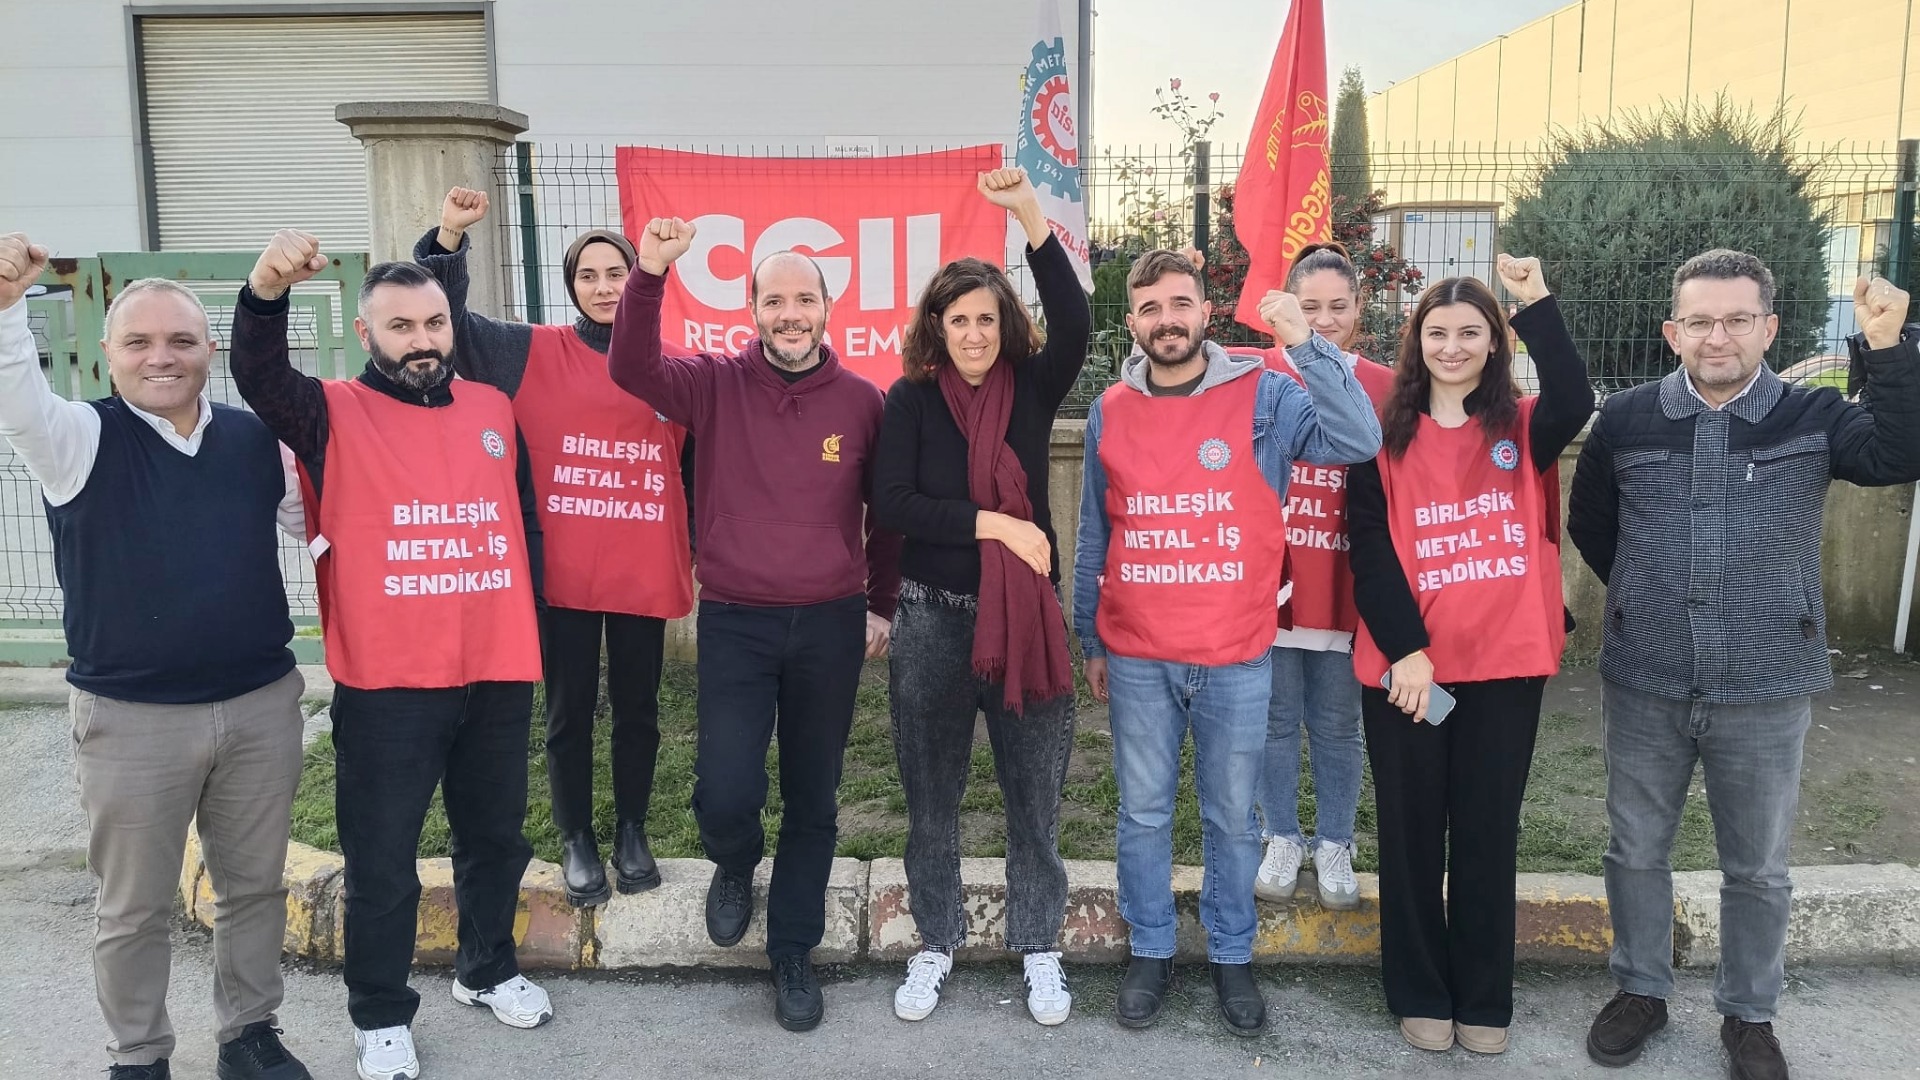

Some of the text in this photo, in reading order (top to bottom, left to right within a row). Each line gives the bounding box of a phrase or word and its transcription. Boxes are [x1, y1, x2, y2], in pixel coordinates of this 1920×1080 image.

[562, 433, 662, 464] BİRLEŞİK
[553, 465, 625, 489] METAL
[644, 469, 665, 496] İŞ
[393, 497, 500, 528] BİRLEŞİK
[547, 495, 664, 522] SENDİKASI
[1126, 488, 1234, 517] BİRLEŞİK
[1415, 488, 1515, 527] BİRLEŞİK
[387, 538, 473, 560] METAL
[488, 530, 508, 560] İŞ
[1124, 529, 1195, 549] METAL
[1217, 522, 1241, 551] İŞ
[1415, 528, 1482, 559] METAL
[1503, 519, 1526, 547] İŞ
[384, 568, 511, 595] SENDİKASI
[1121, 560, 1244, 584] SENDİKASI
